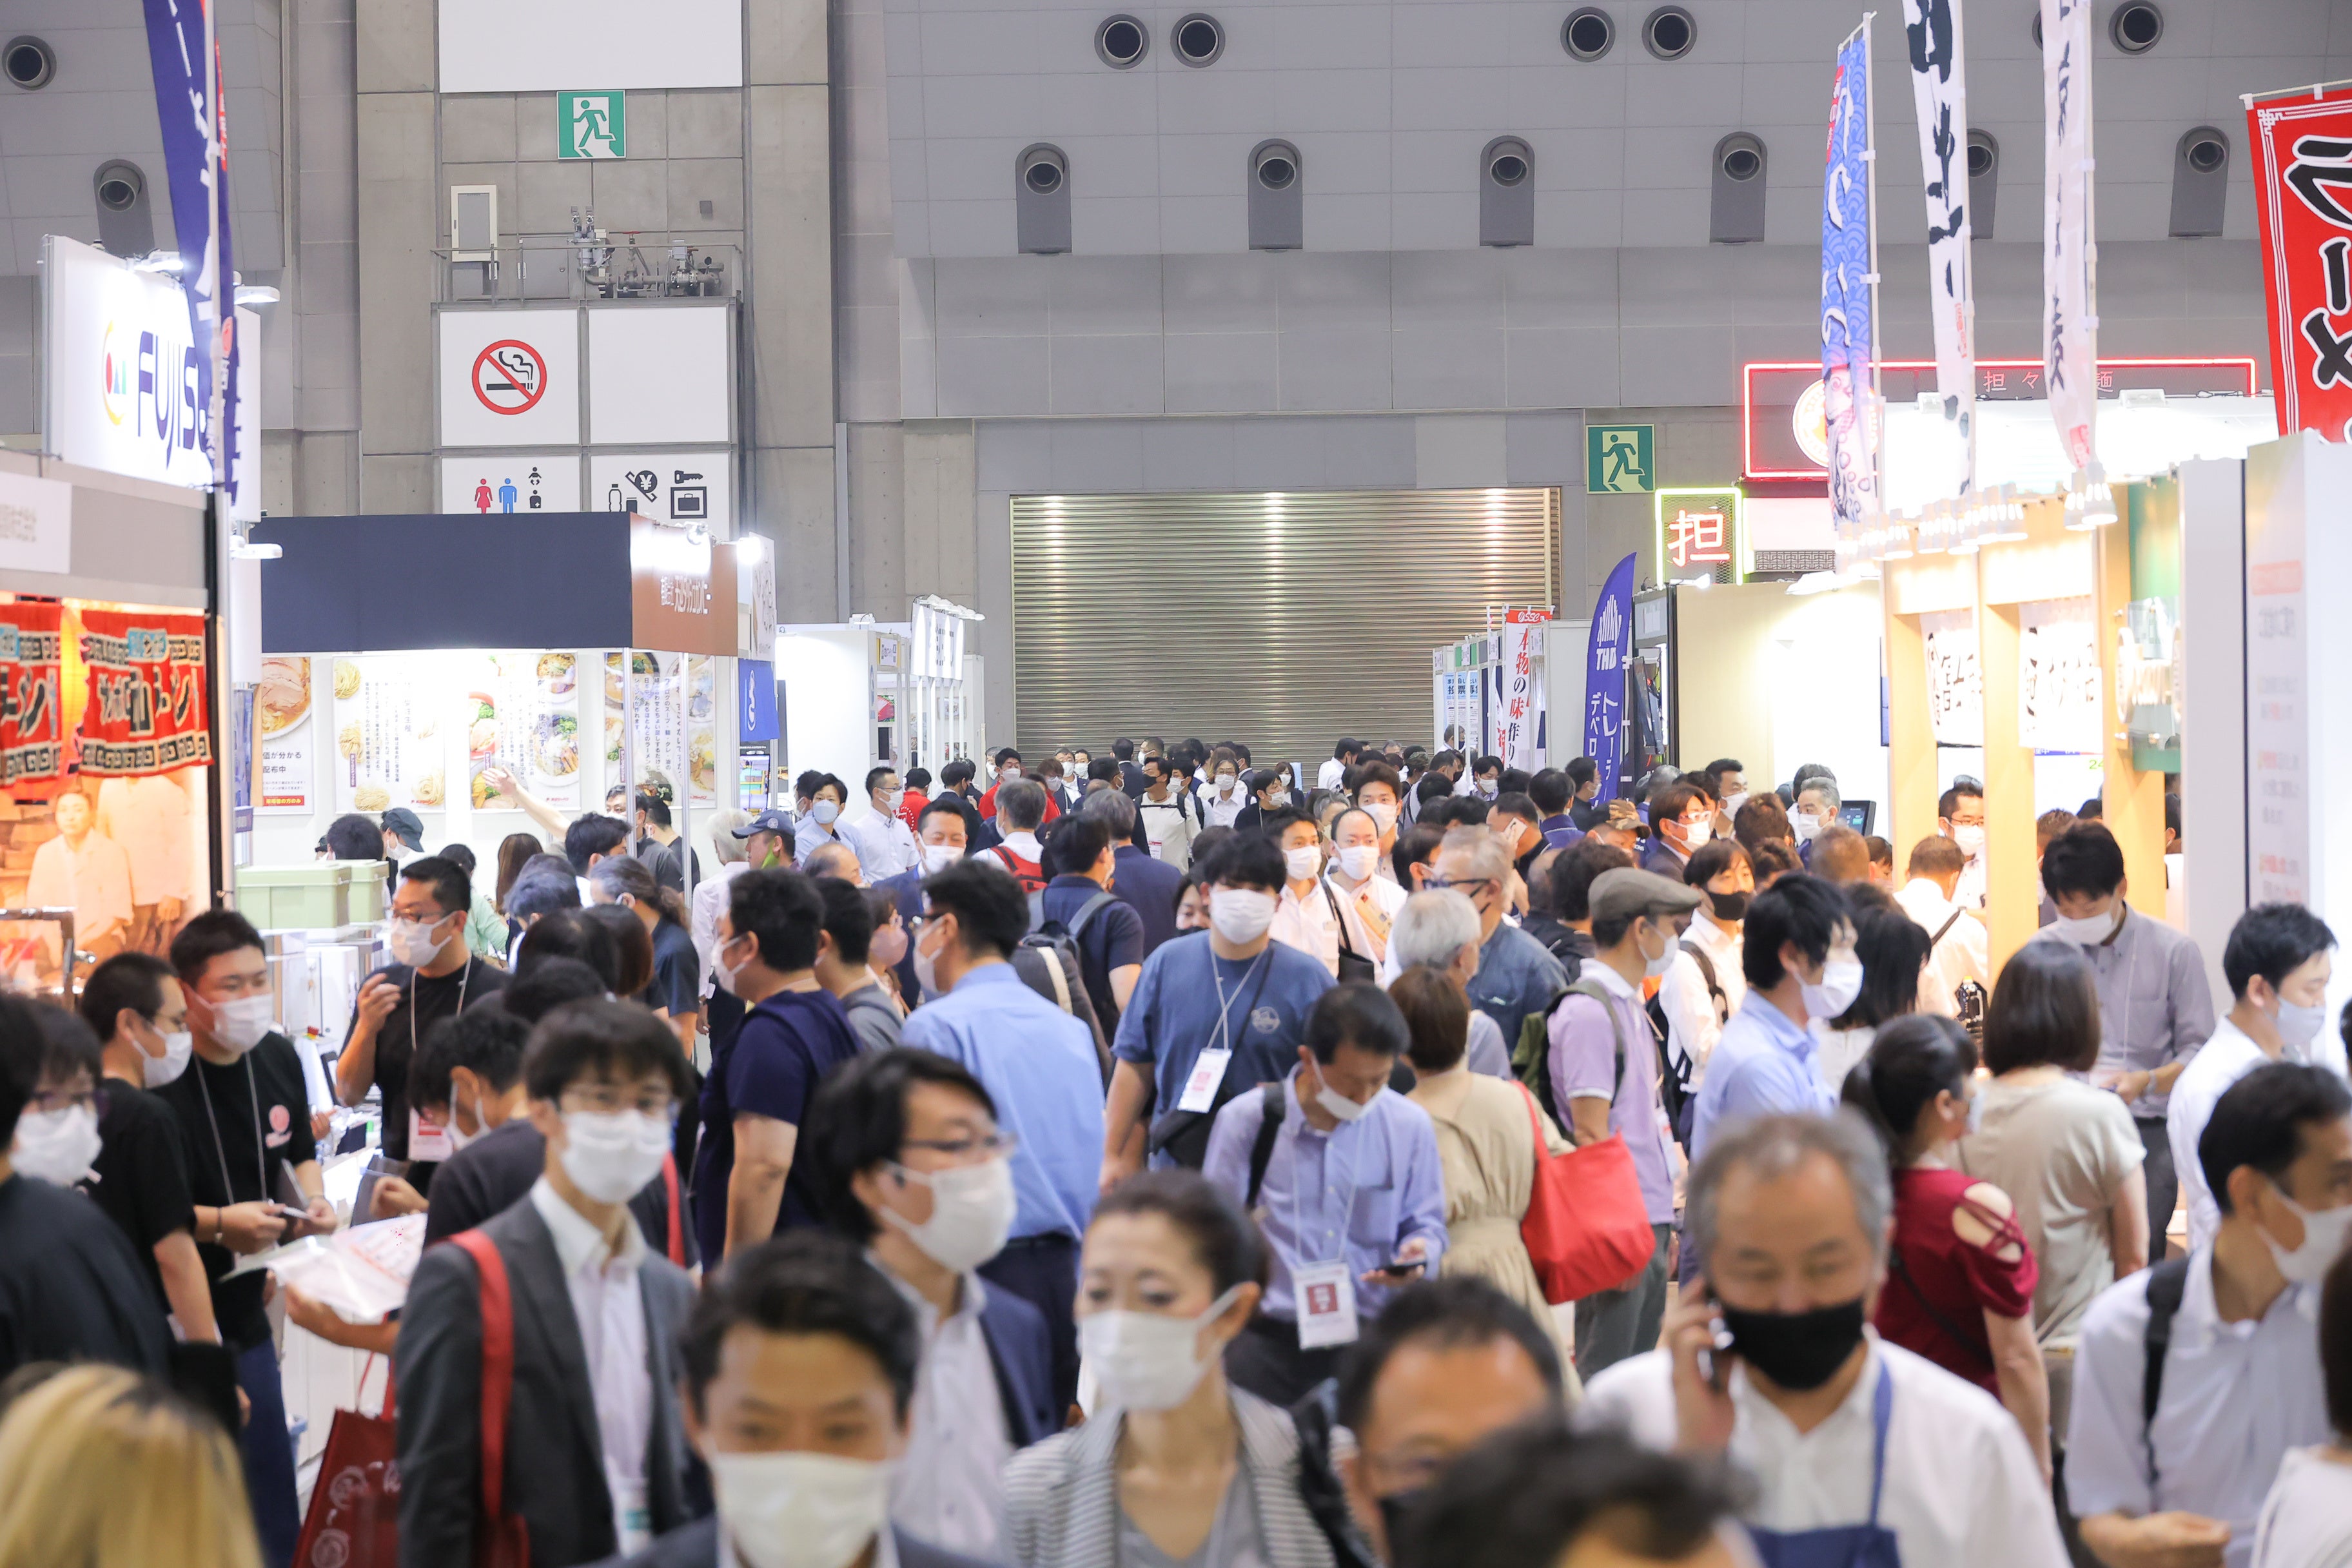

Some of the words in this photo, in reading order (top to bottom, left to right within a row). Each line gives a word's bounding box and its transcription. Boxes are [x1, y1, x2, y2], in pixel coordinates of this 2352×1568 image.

[2284, 134, 2352, 442] ラーメ
[137, 330, 208, 471] FUJIS
[1667, 509, 1730, 567] 担
[1507, 628, 1529, 770] 本物の味作り
